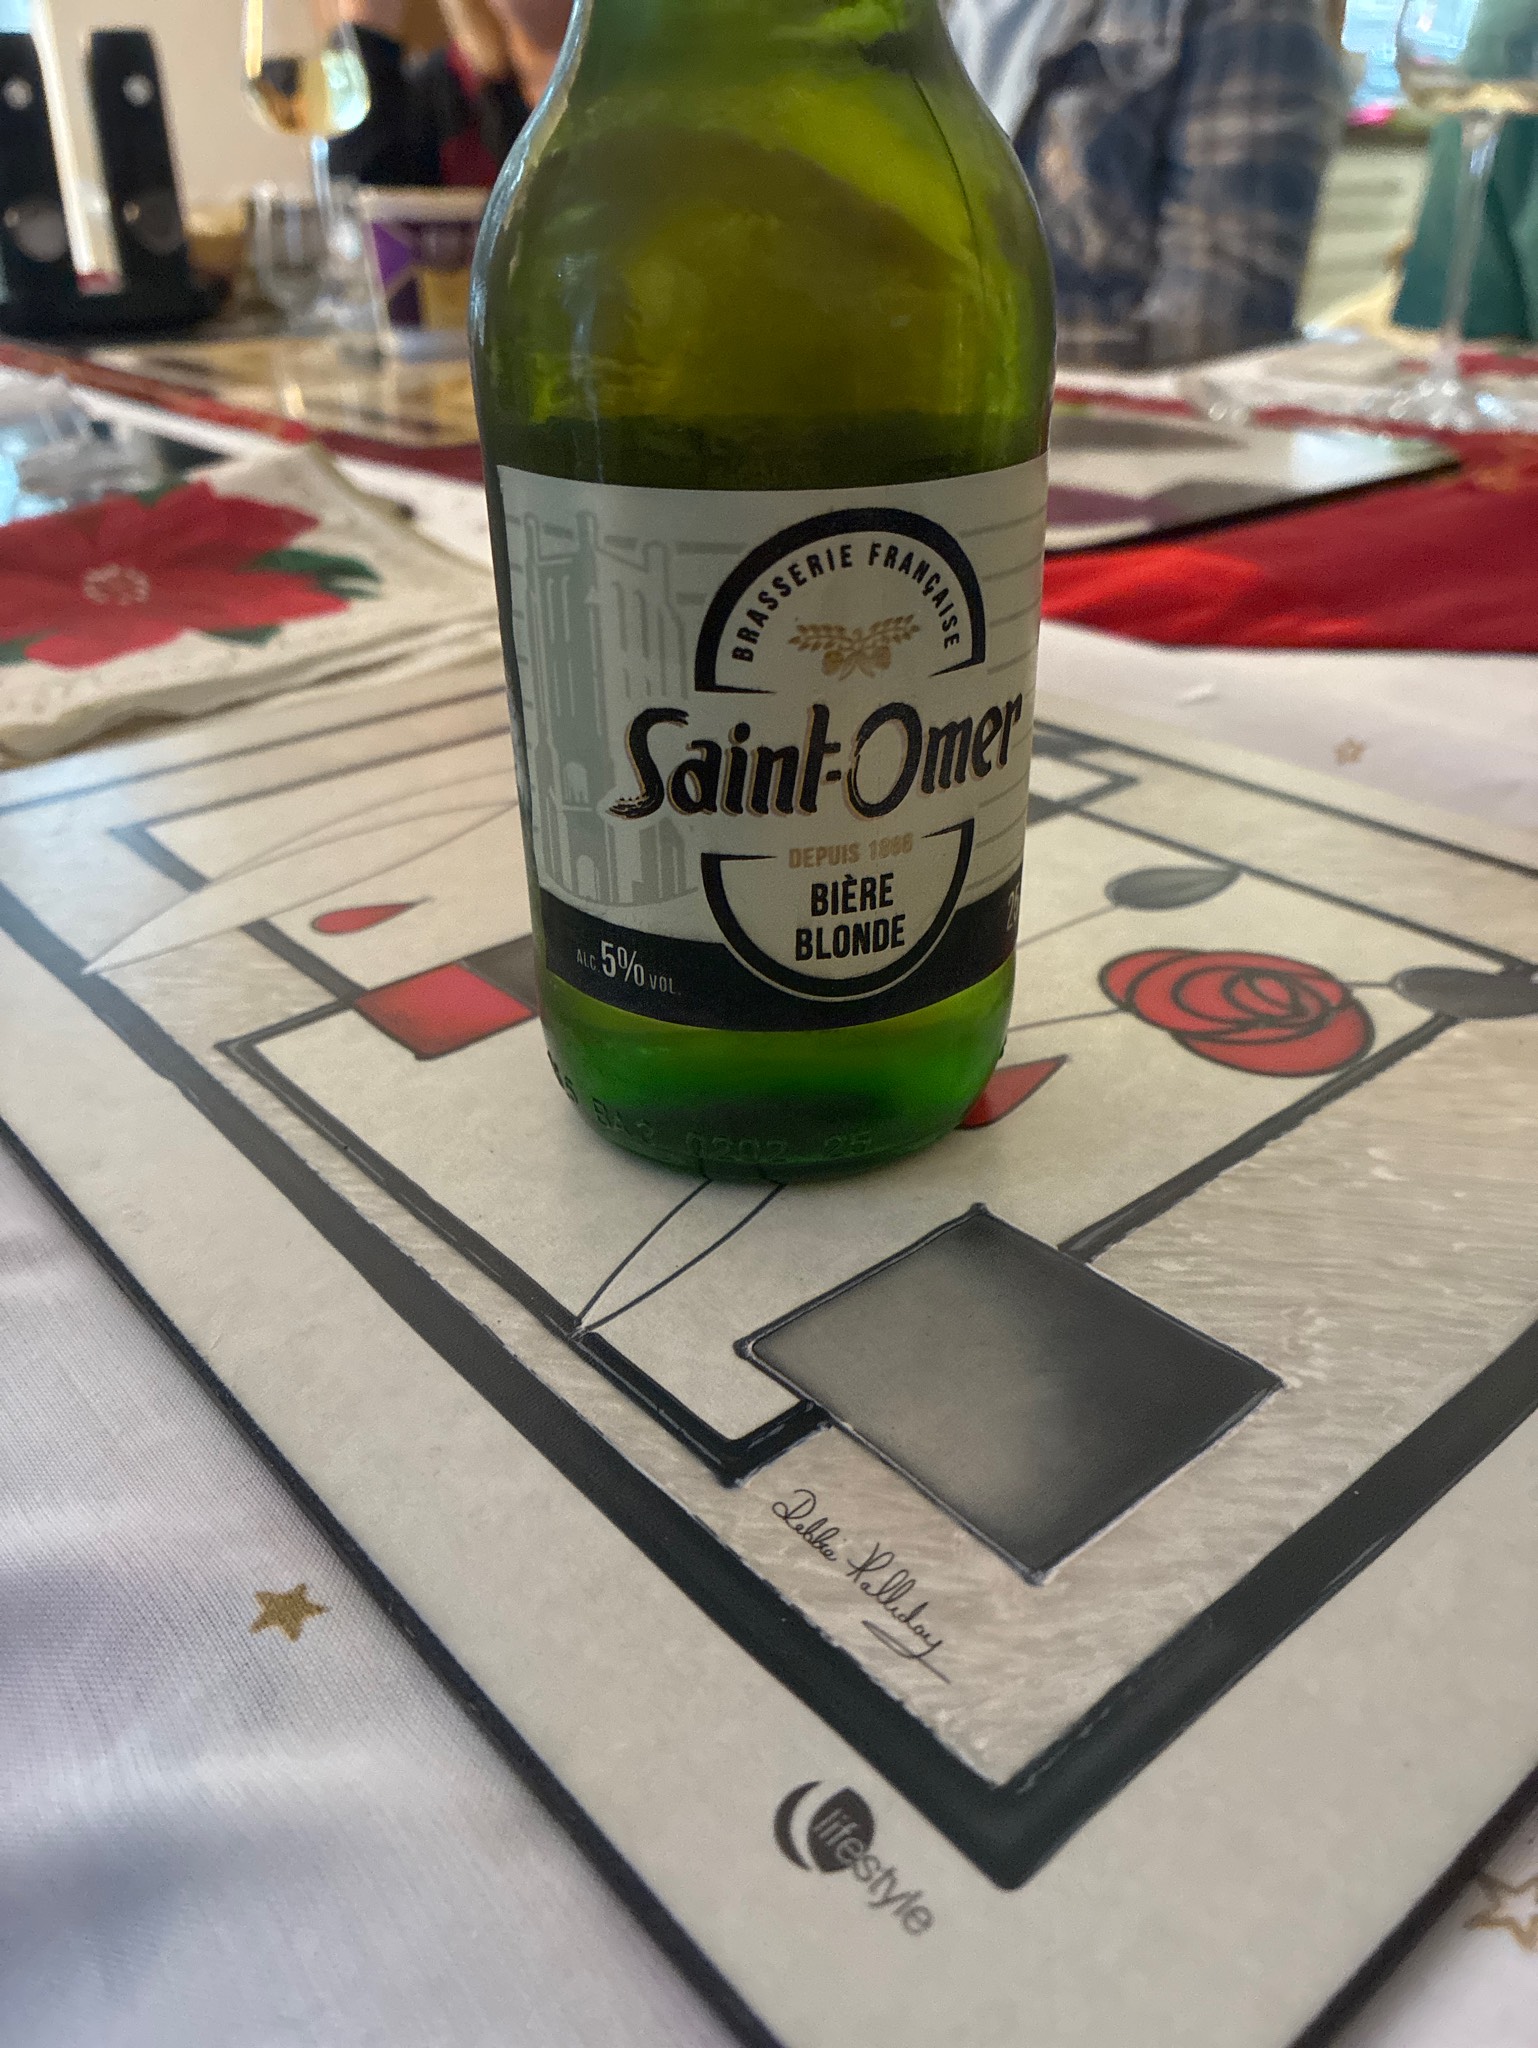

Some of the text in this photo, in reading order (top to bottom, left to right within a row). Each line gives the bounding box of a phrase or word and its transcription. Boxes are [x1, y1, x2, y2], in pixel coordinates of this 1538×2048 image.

[731, 542, 961, 664] BRASSERIE FRANÇAISE
[606, 692, 1023, 820] Saint-Omer
[788, 842, 861, 869] DEPUIS
[810, 873, 895, 917] BIÈRE
[795, 914, 906, 963] BLONDE
[601, 940, 645, 987] 5%
[814, 1806, 936, 1937] lifestyle
